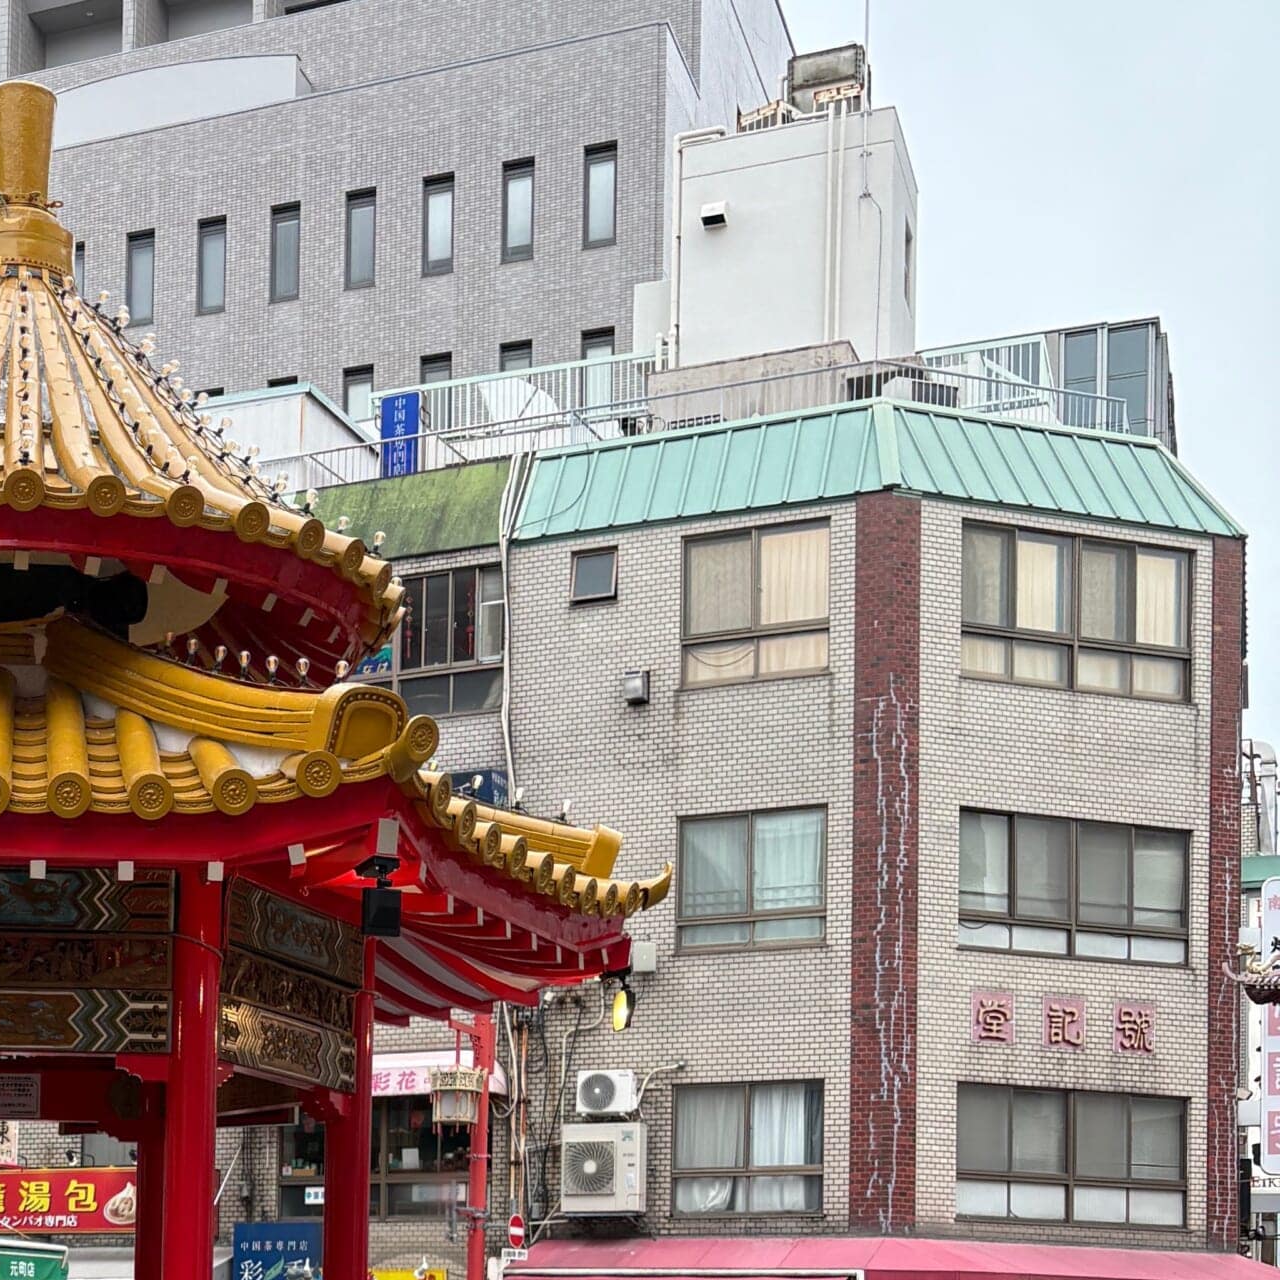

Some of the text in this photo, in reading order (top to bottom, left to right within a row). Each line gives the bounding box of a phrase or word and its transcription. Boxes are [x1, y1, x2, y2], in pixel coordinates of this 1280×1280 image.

[976, 999, 1153, 1052] 堂記號
[10, 1261, 35, 1278] 元町店
